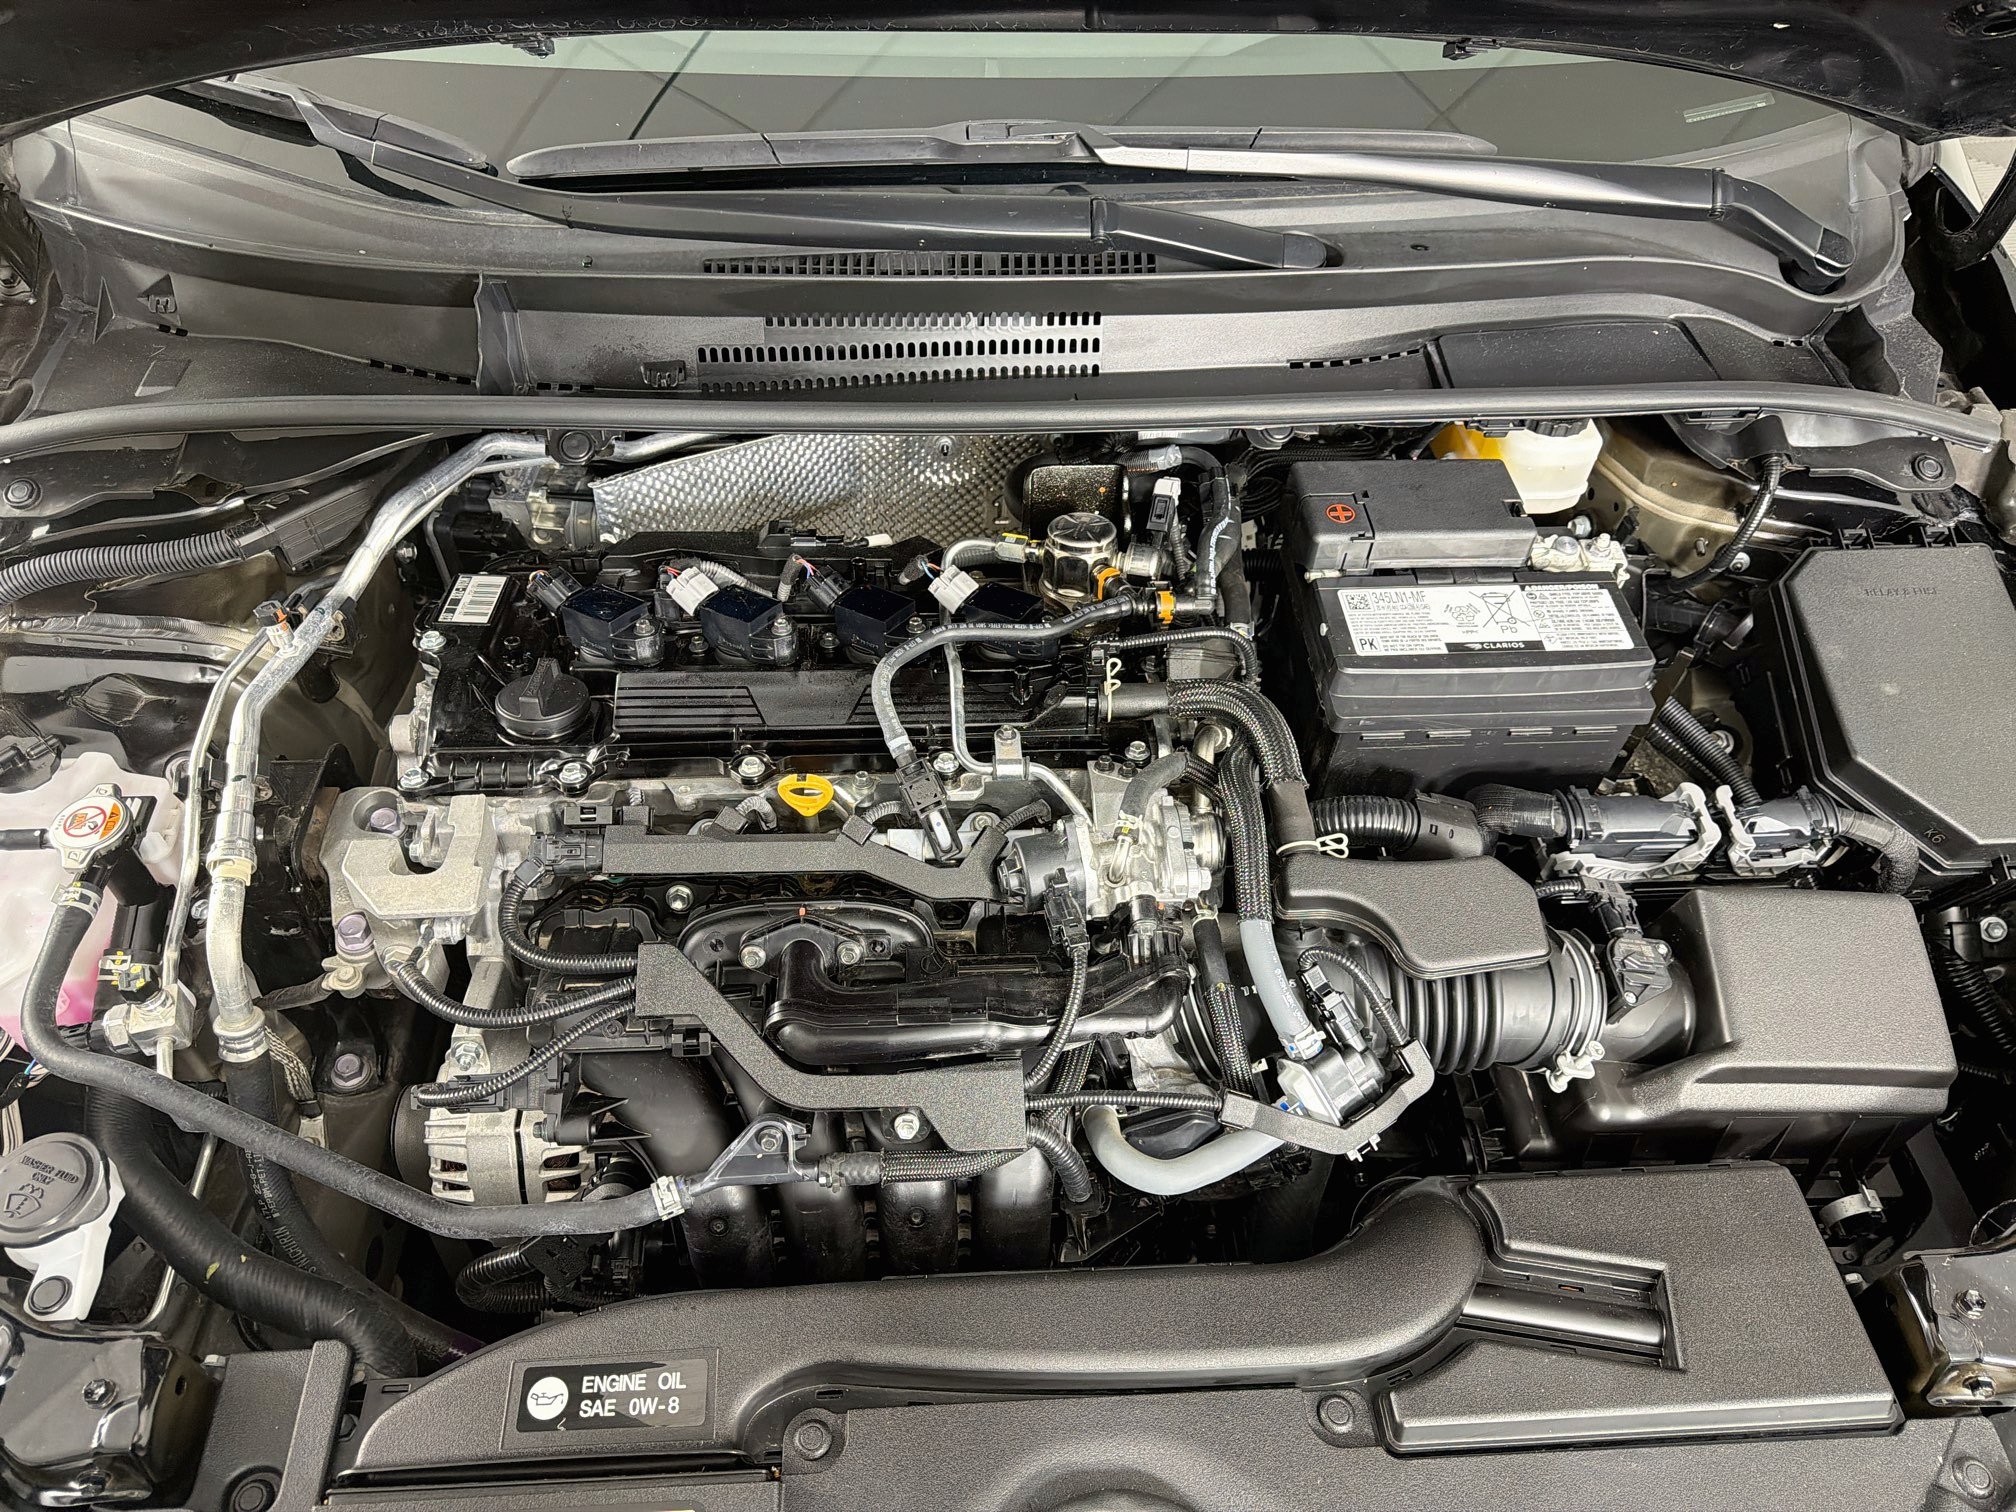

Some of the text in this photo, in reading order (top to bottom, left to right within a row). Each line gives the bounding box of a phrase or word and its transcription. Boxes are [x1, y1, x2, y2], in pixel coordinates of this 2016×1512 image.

[1371, 590, 1426, 604] 345LN1-MF
[1501, 625, 1518, 633] Pb
[1359, 638, 1378, 651] PK
[20, 1155, 79, 1184] WASHER FLUID
[32, 1171, 55, 1185] ONLY
[581, 1371, 686, 1393] ENGINE OIL
[578, 1396, 680, 1418] SAE 0W-8
